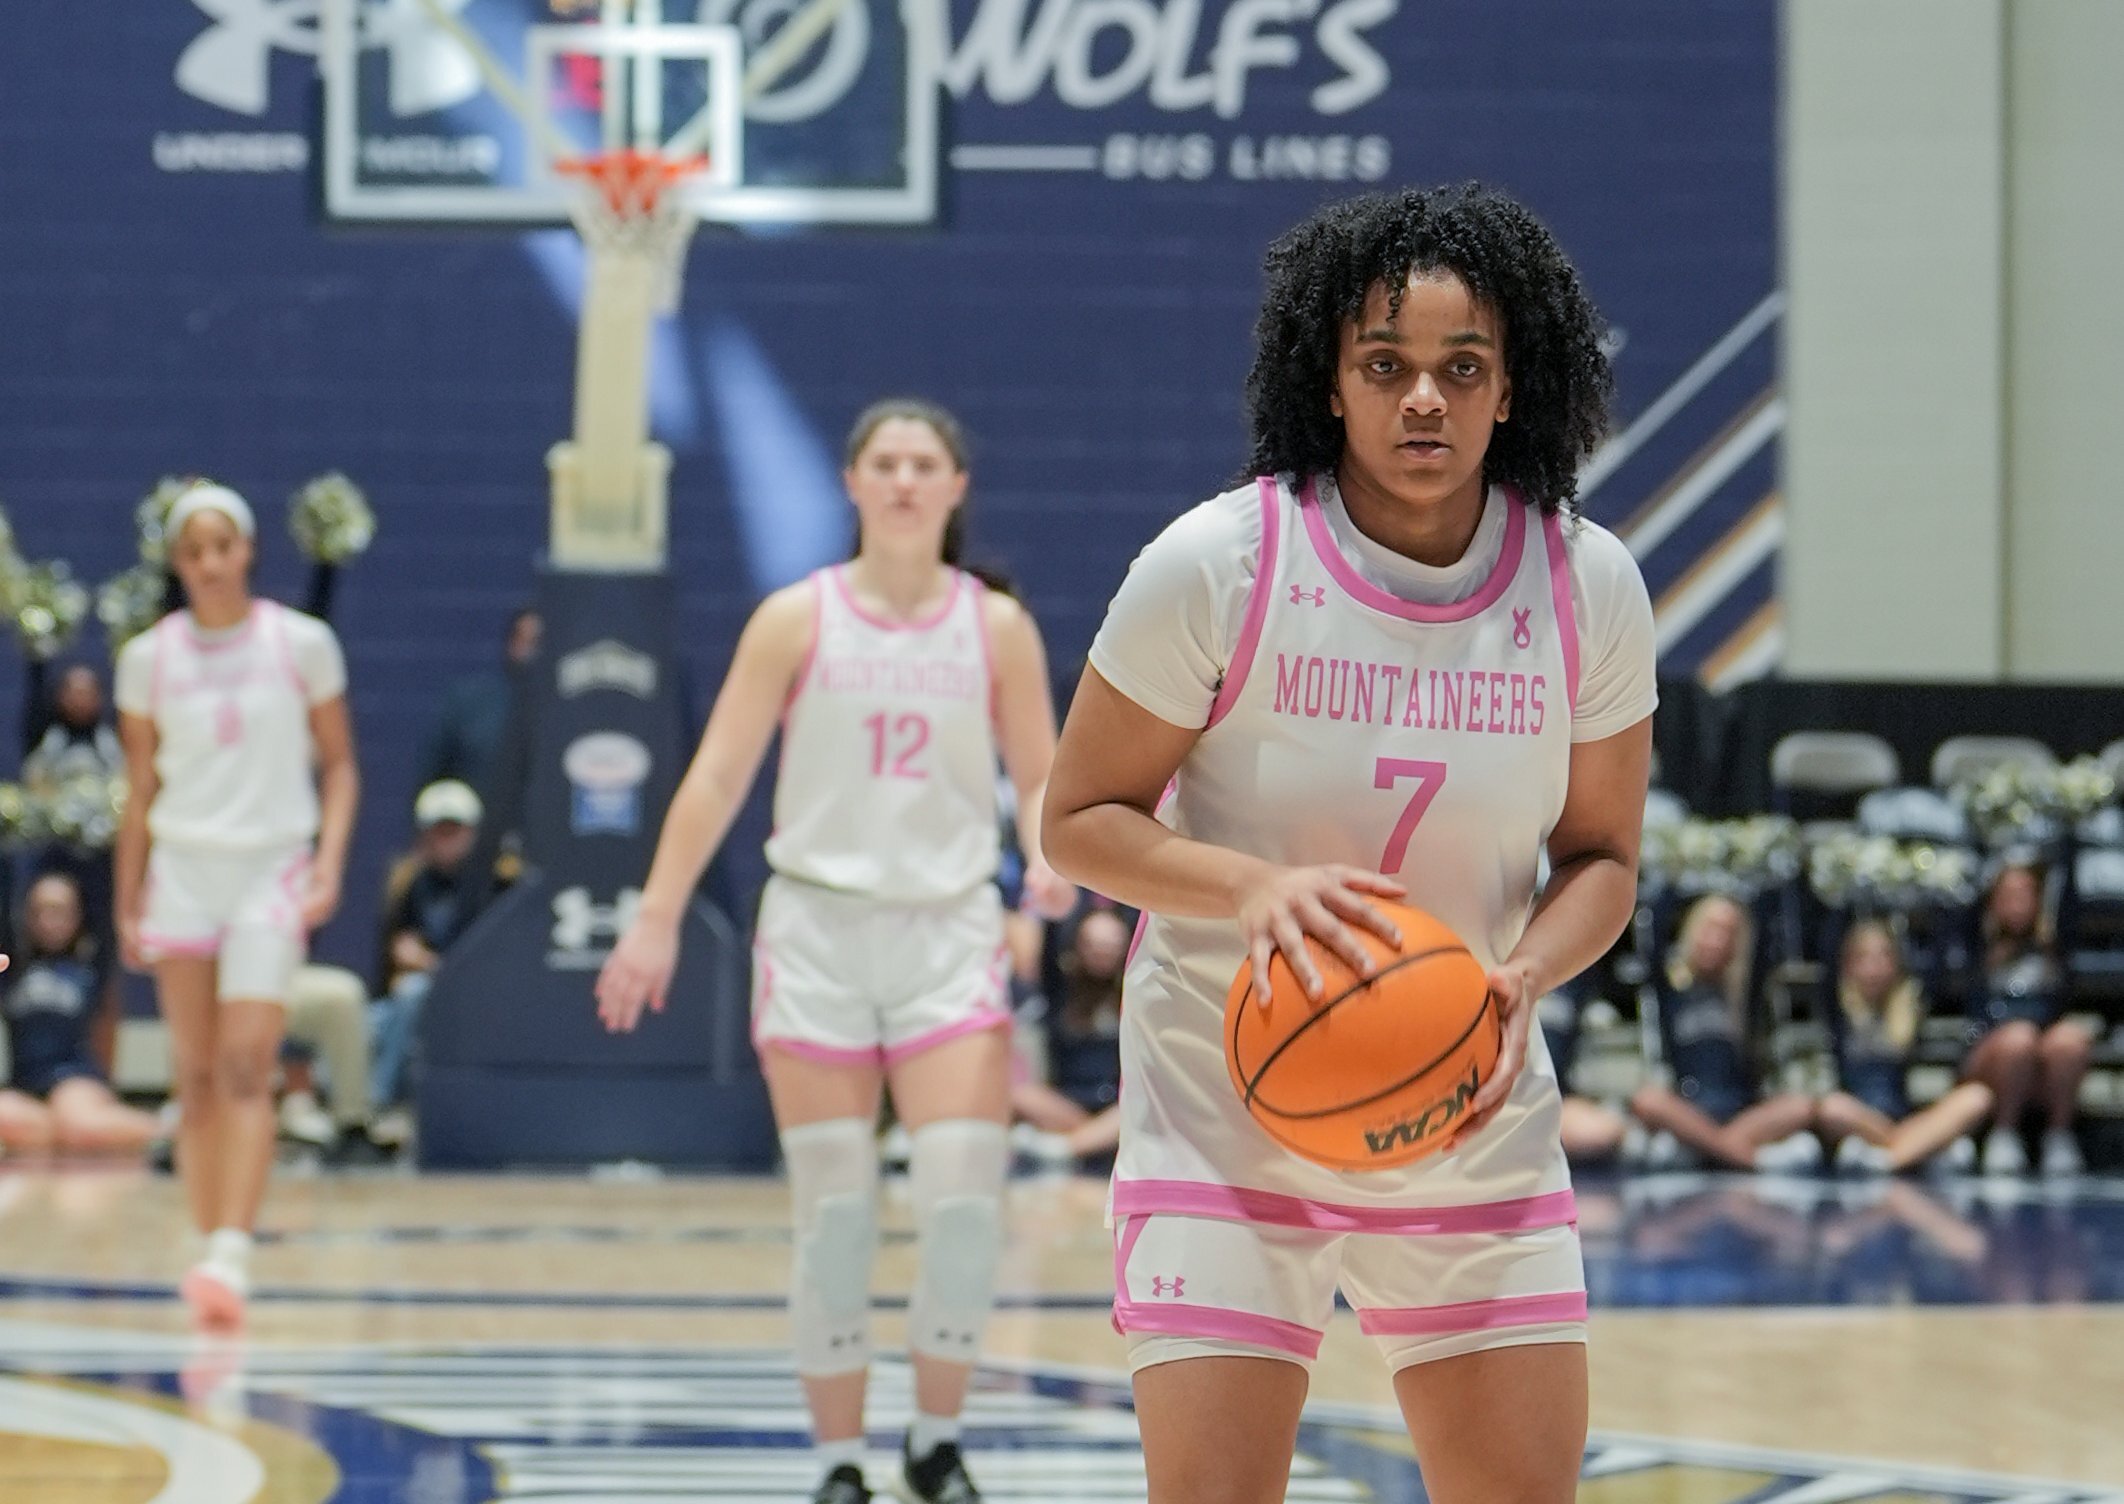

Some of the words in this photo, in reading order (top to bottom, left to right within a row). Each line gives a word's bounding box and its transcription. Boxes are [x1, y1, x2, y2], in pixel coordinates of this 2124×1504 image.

[1102, 133, 1215, 181] BUS
[1229, 133, 1392, 182] LINES
[1273, 653, 1548, 736] MOUNTAINEERS
[862, 709, 933, 781] 12
[1373, 756, 1448, 876] 7
[1363, 1062, 1482, 1154] NCAA
